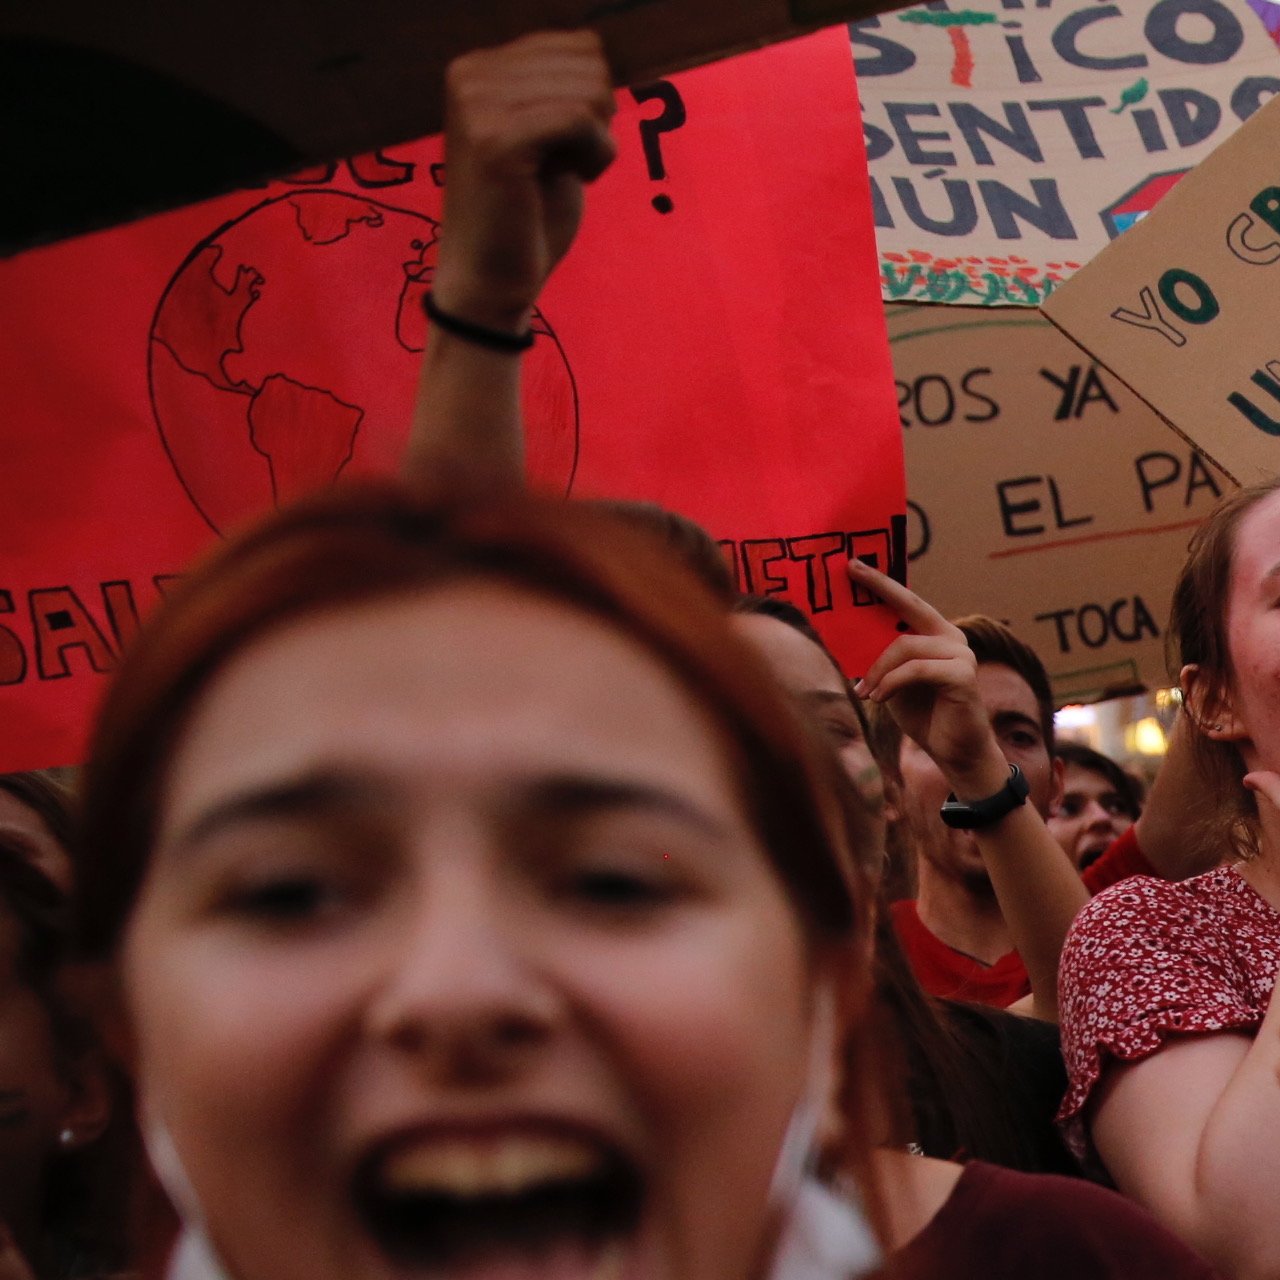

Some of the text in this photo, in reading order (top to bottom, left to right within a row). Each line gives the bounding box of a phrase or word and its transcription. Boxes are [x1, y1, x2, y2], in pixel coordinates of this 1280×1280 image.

[872, 168, 1079, 240] ÚN
[1112, 267, 1220, 347] YO
[1039, 364, 1120, 421] YA
[996, 474, 1094, 537] EL
[1035, 594, 1160, 654] TOCA
